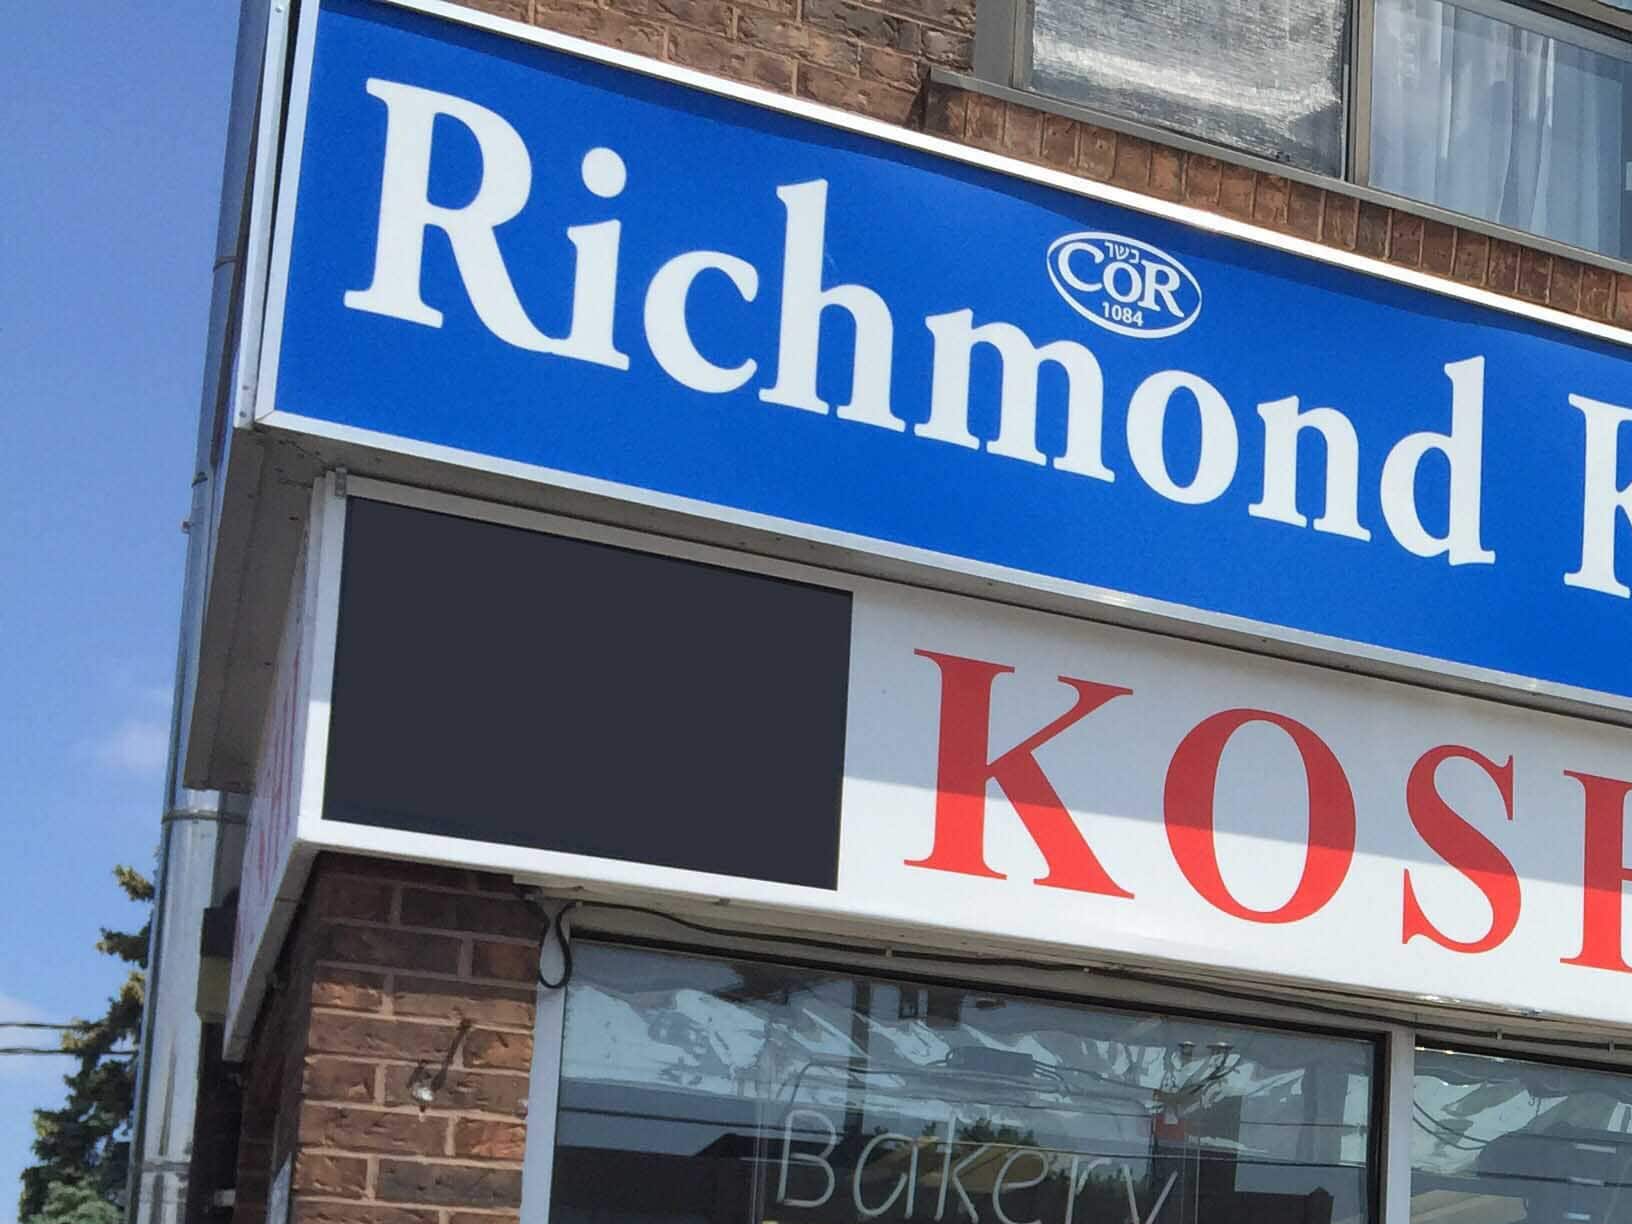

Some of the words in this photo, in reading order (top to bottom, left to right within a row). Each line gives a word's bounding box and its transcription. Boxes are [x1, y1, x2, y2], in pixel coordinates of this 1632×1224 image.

[1058, 242, 1185, 318] COR
[1102, 301, 1144, 327] 1084
[344, 78, 1496, 566] Richmond
